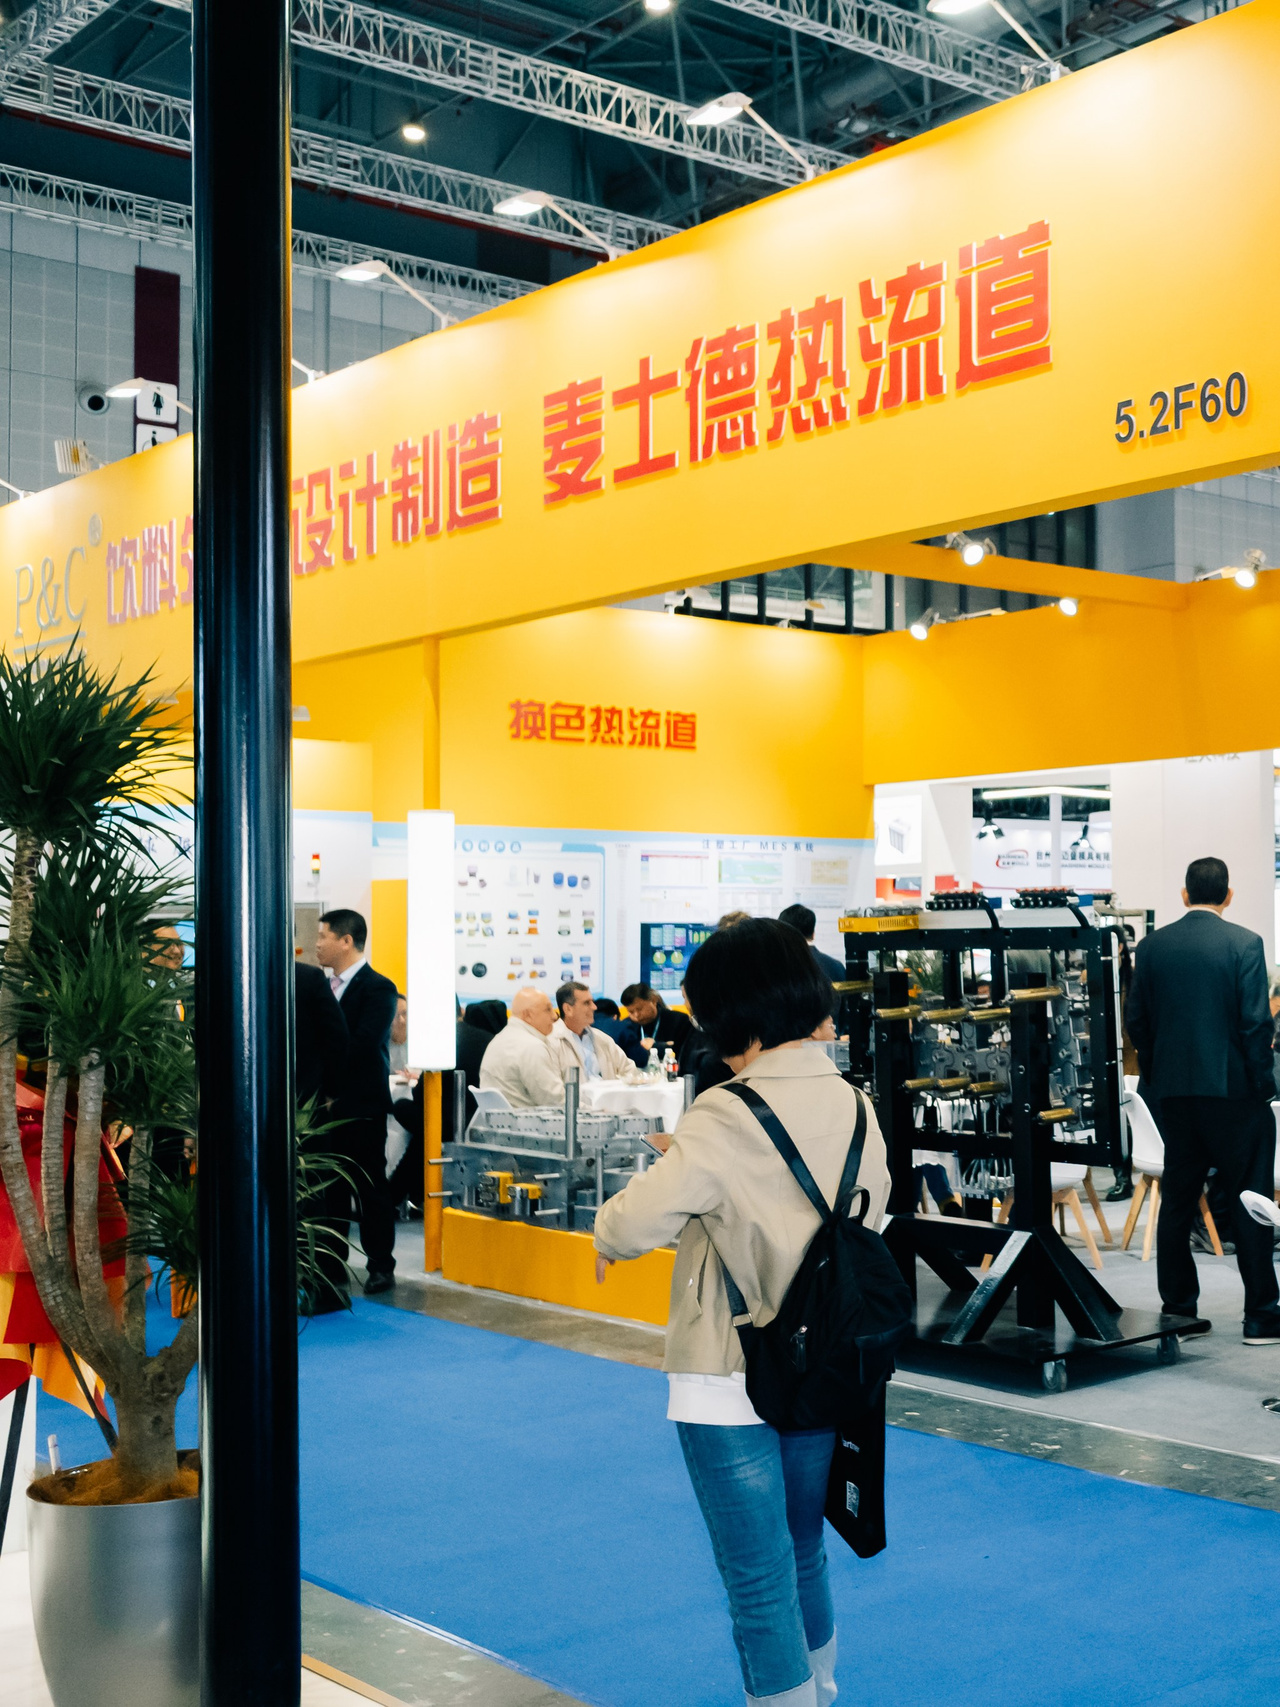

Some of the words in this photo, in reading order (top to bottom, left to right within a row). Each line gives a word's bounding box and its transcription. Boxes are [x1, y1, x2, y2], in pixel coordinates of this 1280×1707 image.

[543, 219, 1053, 506] 麦士德热流道
[1114, 371, 1248, 443] 5.2F60
[14, 546, 87, 637] P&C
[508, 699, 697, 750] 换色热流道
